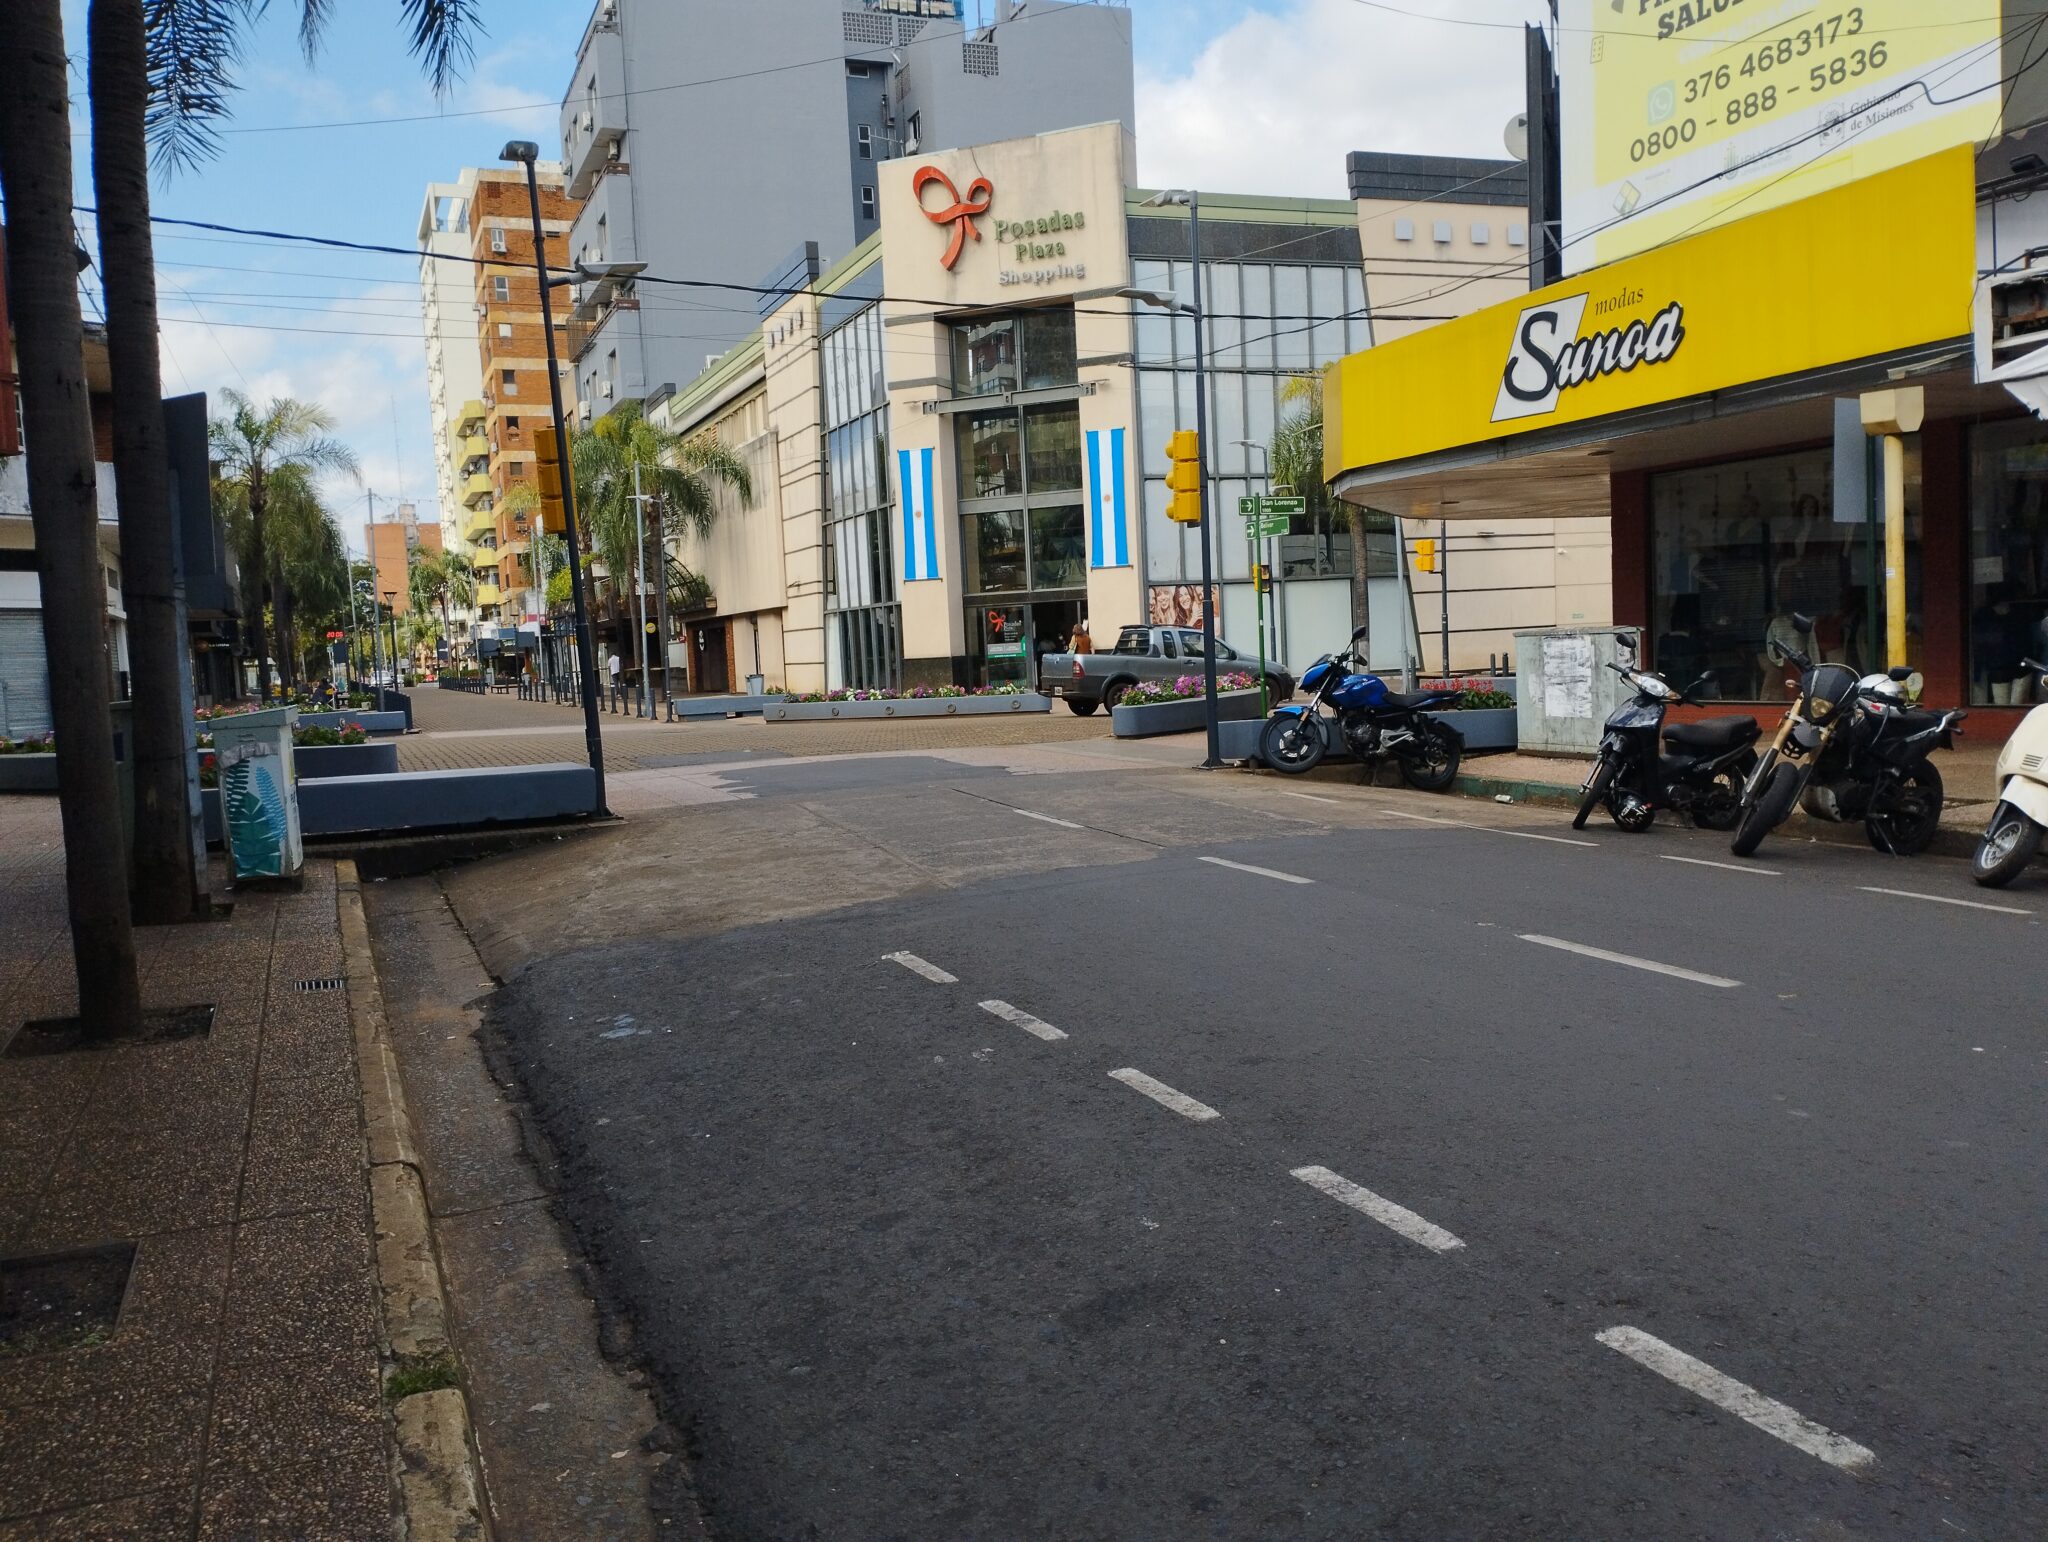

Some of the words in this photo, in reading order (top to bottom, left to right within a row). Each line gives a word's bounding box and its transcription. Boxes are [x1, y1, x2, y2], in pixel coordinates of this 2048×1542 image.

[1684, 64, 1731, 103] 376
[1739, 7, 1864, 77] 4683173
[1629, 117, 1697, 162] 0800
[1726, 84, 1777, 125] 888
[1809, 40, 1888, 92] 5836
[1850, 119, 1863, 130] de
[1866, 102, 1914, 125] Misiones
[993, 210, 1085, 241] Posadas
[1014, 241, 1066, 262] Plaza
[999, 264, 1086, 286] Shopping
[1595, 287, 1644, 316] modas
